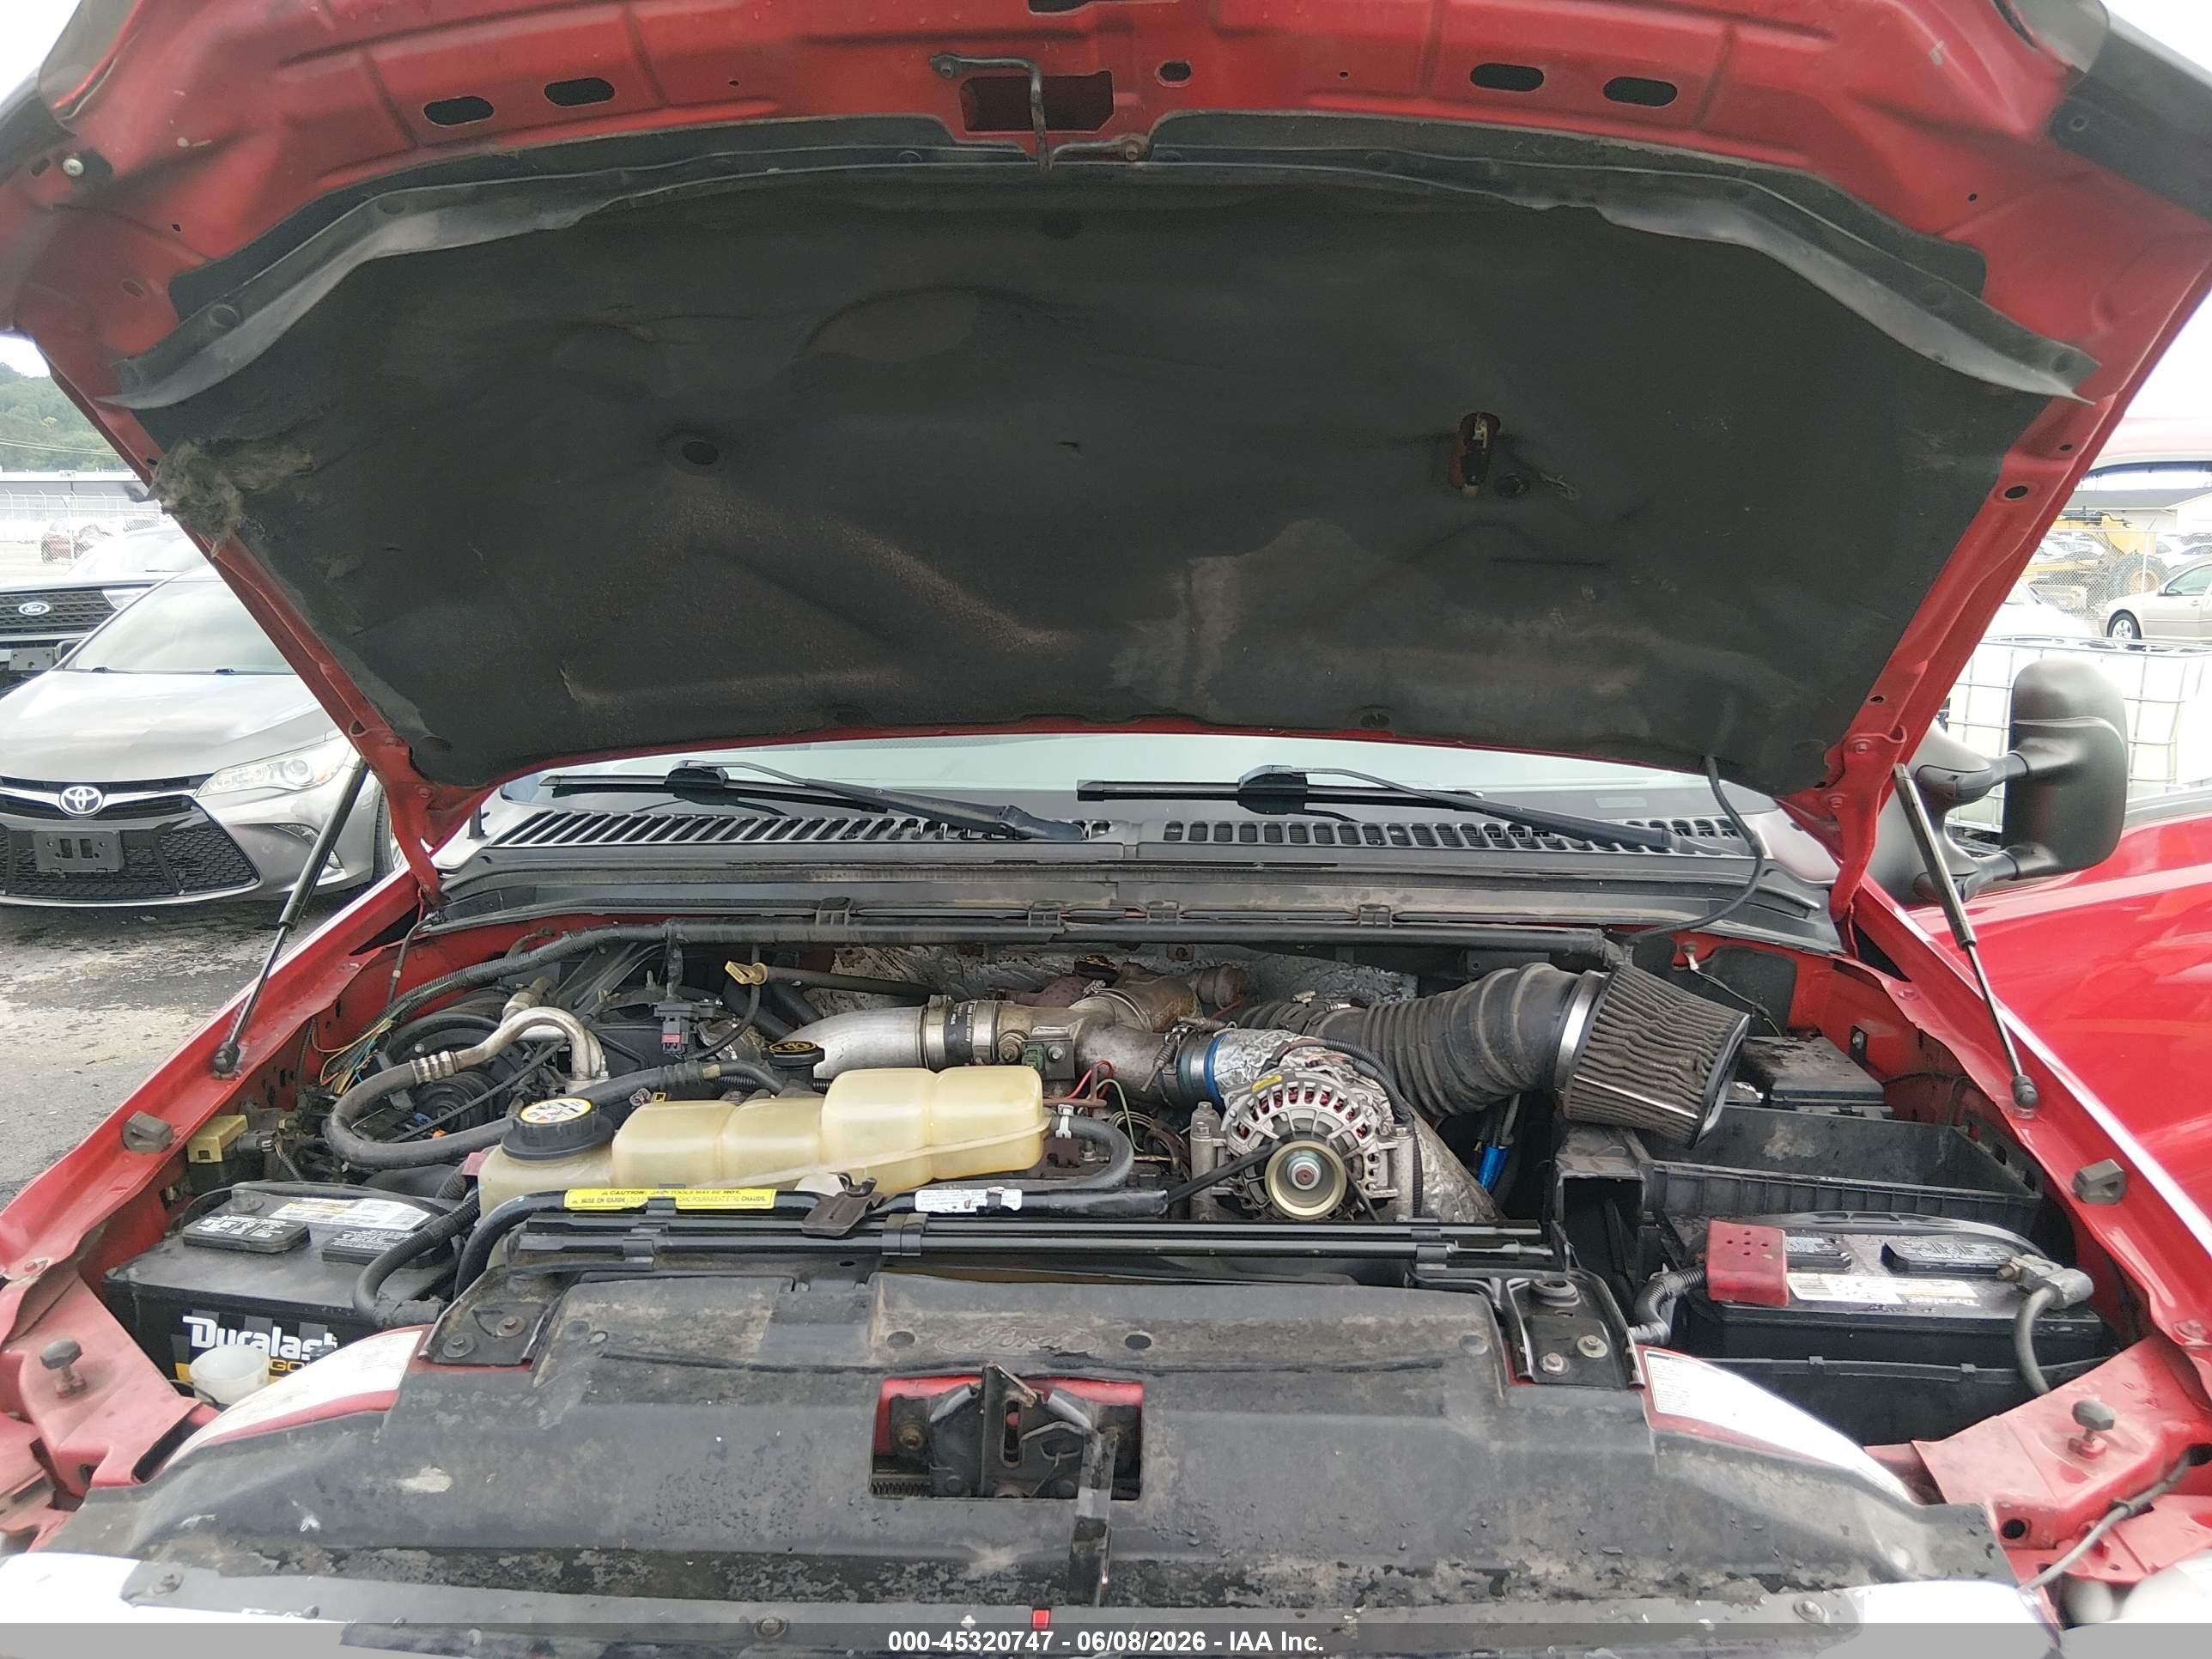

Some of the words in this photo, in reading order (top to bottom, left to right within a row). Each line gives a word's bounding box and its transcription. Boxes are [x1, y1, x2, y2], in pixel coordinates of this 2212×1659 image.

[182, 1316, 338, 1361] Duralast
[968, 1325, 1068, 1350] Ford
[270, 1358, 307, 1373] GO
